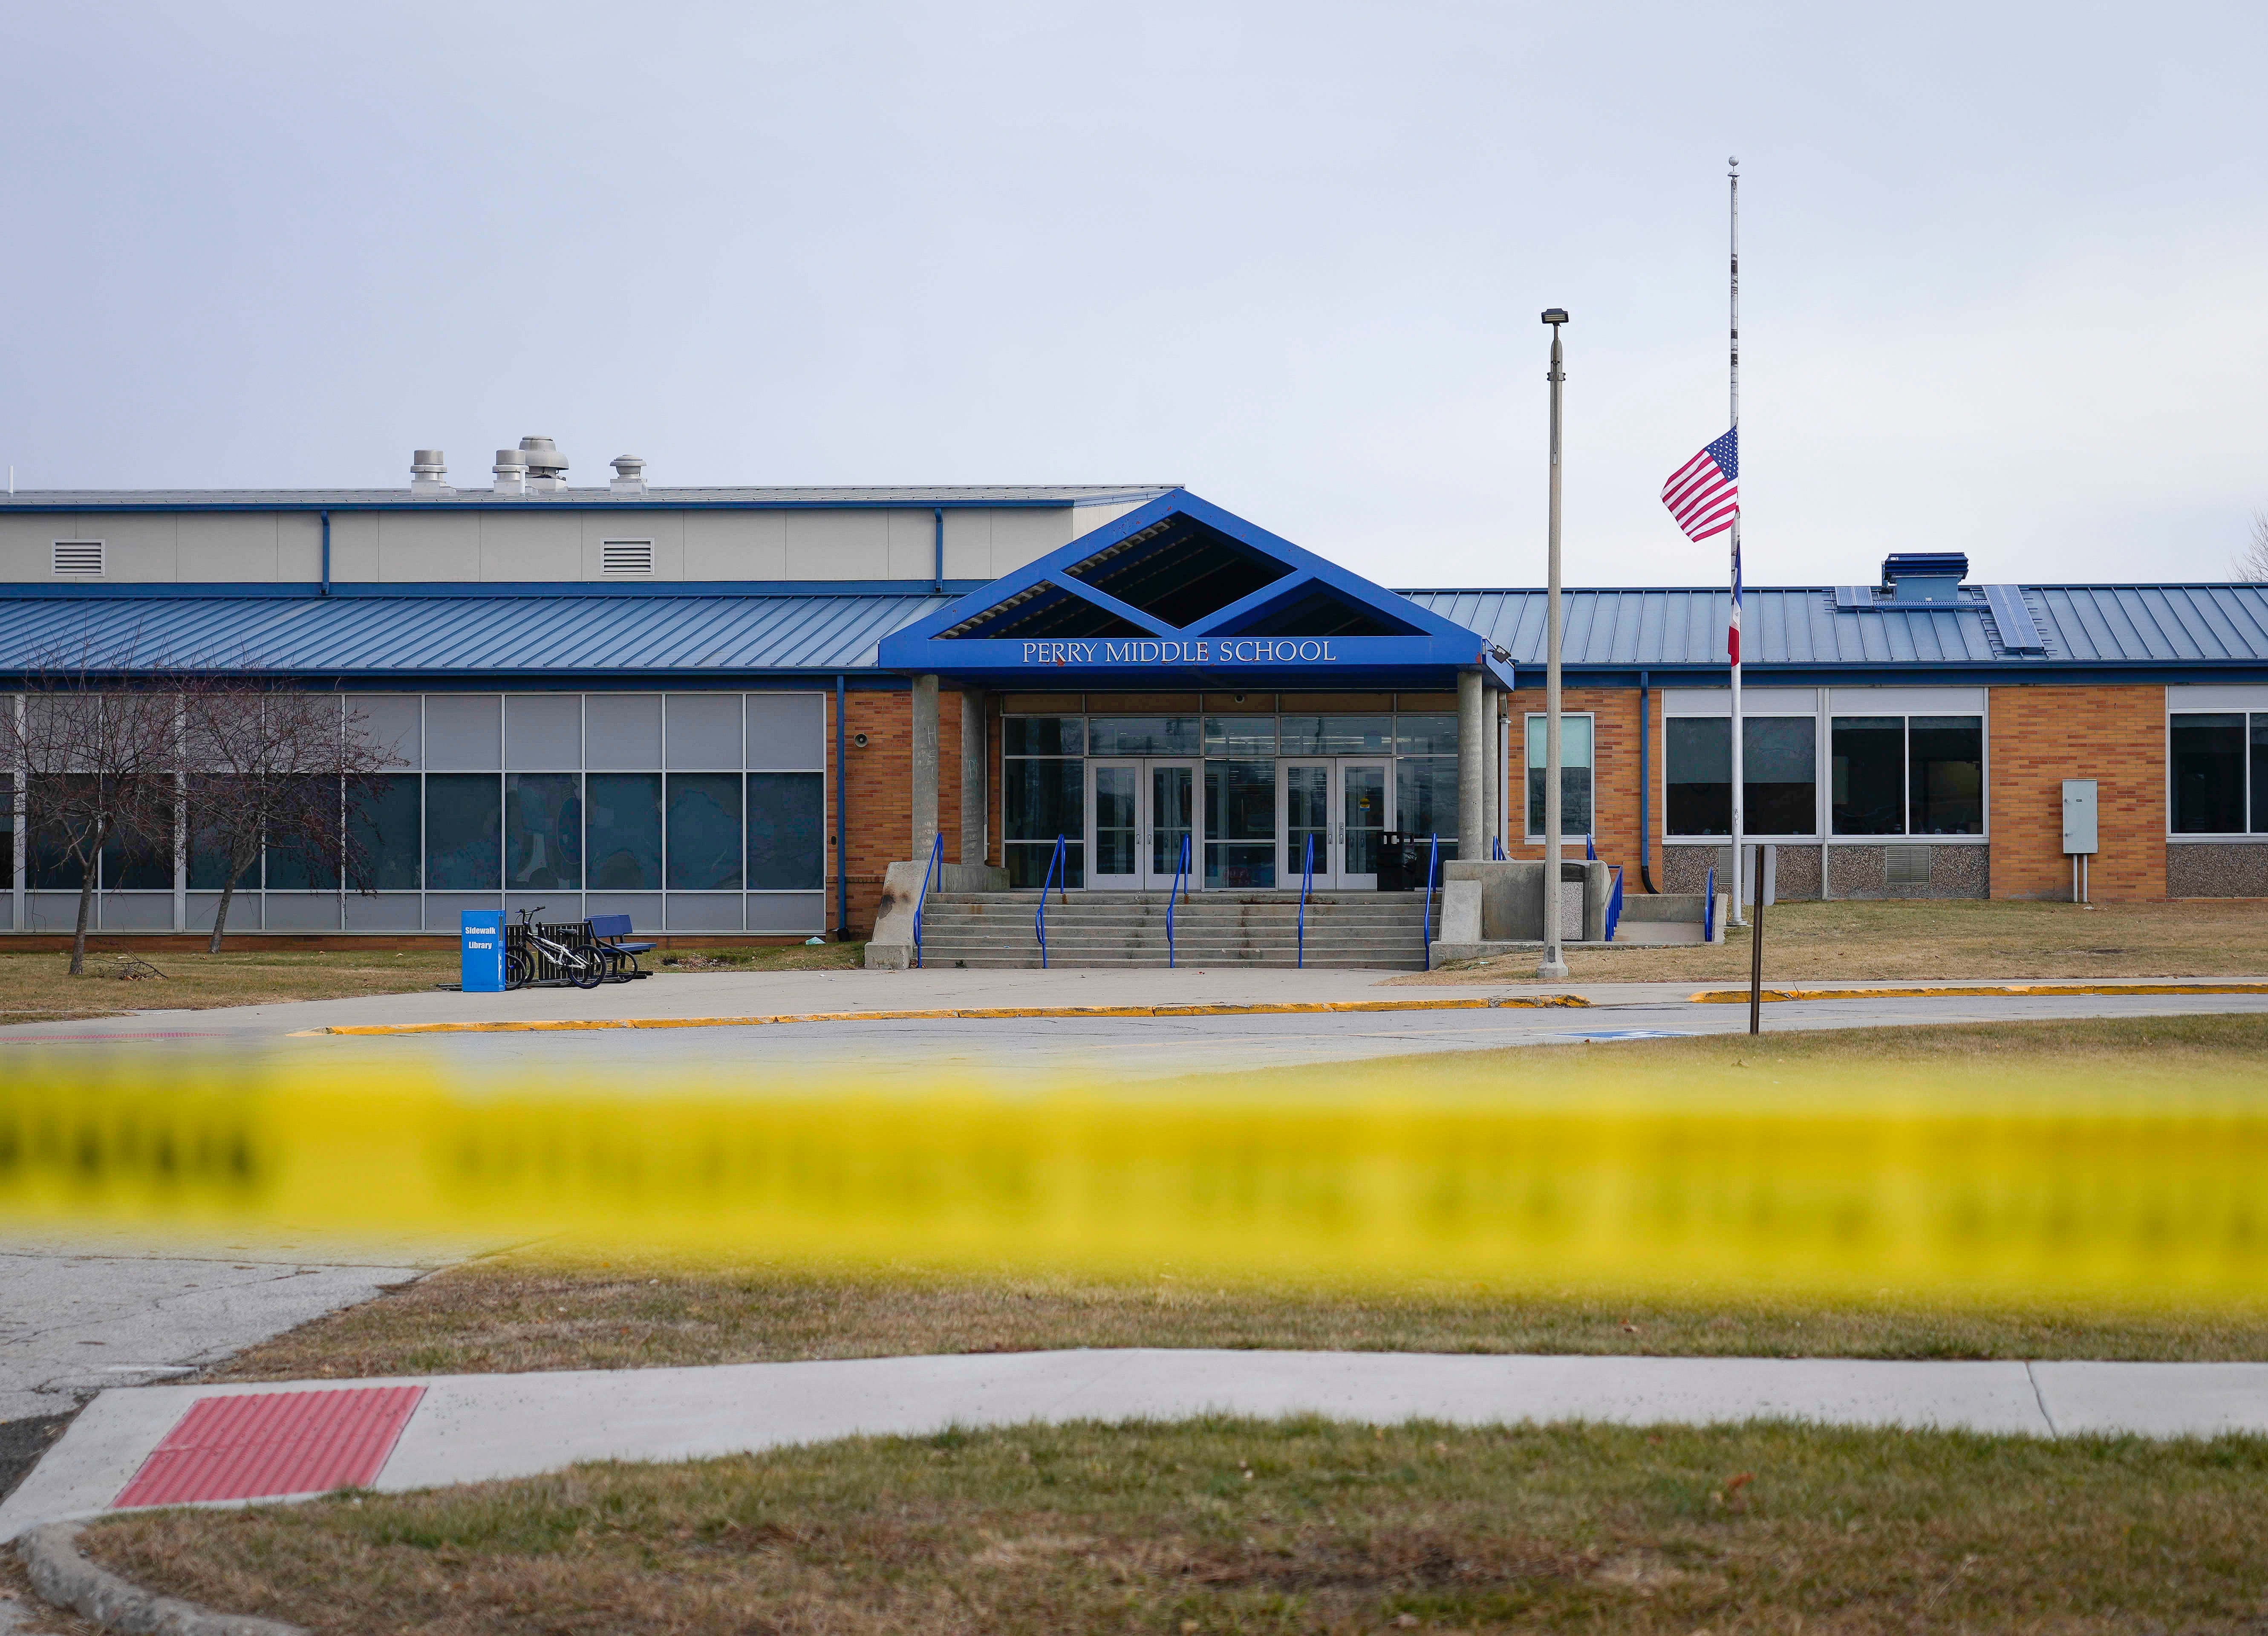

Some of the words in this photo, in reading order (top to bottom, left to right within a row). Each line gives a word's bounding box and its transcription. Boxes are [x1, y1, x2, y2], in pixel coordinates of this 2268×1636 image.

[1022, 642, 1098, 662] PERRY
[1105, 641, 1209, 662] MIDDLE
[1220, 640, 1336, 661] SCHOOL
[465, 926, 496, 935] Sidewalk
[468, 941, 492, 950] Library
